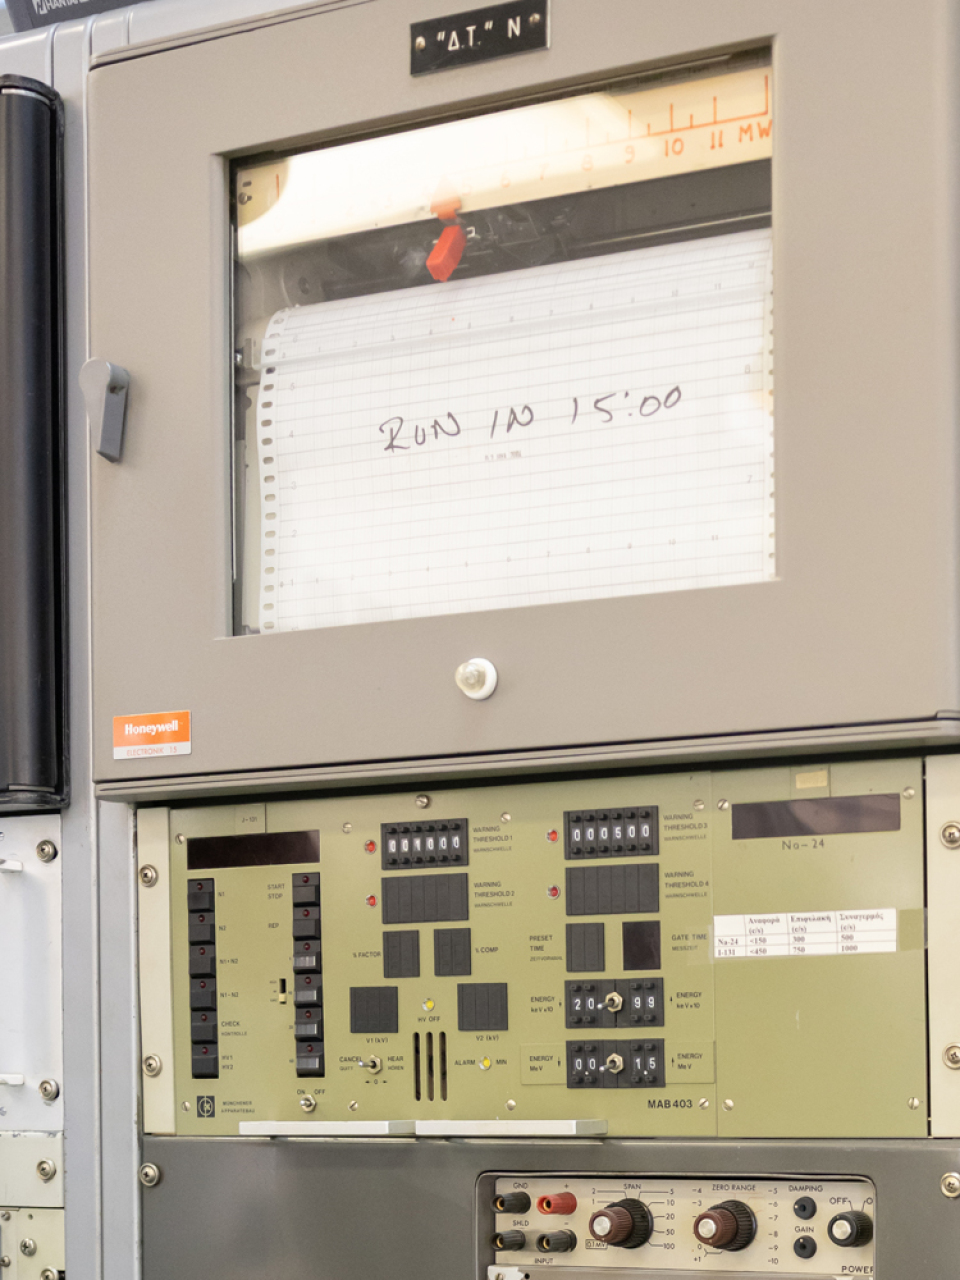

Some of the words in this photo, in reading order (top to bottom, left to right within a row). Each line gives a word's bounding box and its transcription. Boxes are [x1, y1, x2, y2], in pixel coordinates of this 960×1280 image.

[625, 144, 636, 164] 9
[664, 137, 685, 158] 10
[379, 411, 461, 453] RUN
[489, 404, 535, 439] IN
[124, 720, 179, 736] Honeywell
[732, 1184, 756, 1192] RANGE
[788, 1184, 823, 1193] DAMPING
[829, 1197, 848, 1205] OFF
[794, 1225, 814, 1233] GAIN
